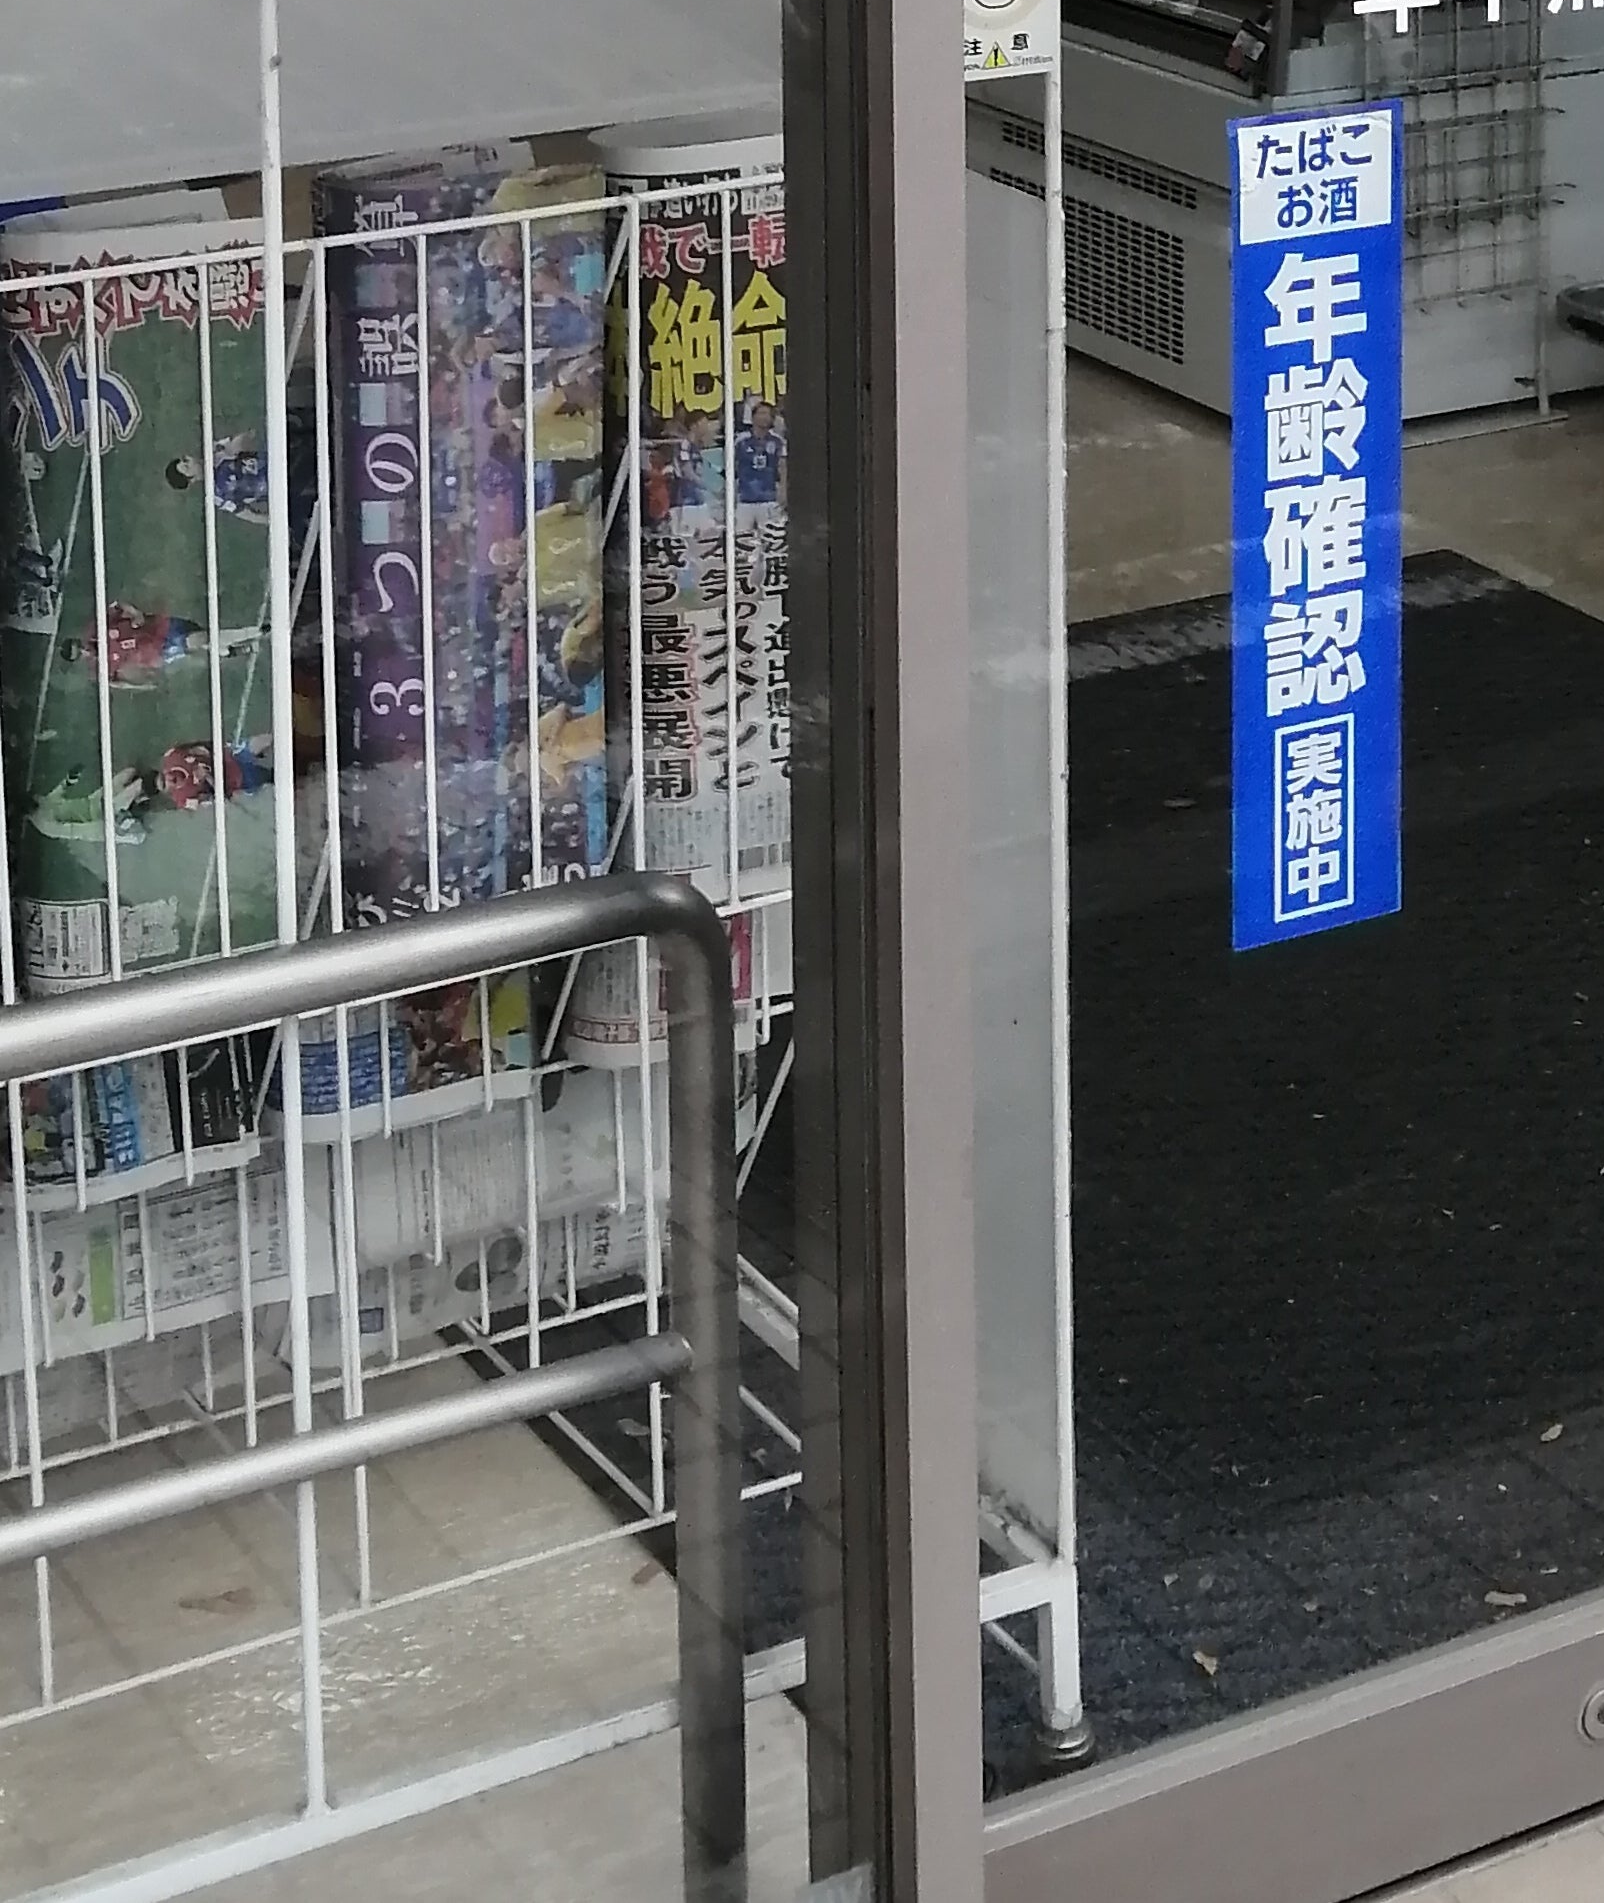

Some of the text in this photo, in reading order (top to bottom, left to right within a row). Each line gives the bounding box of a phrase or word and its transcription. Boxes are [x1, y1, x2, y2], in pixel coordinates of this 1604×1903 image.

[1256, 122, 1375, 178] たばこ
[1275, 178, 1360, 232] お酒
[1262, 251, 1370, 719] 年齢確認
[1285, 731, 1344, 904] 実施中
